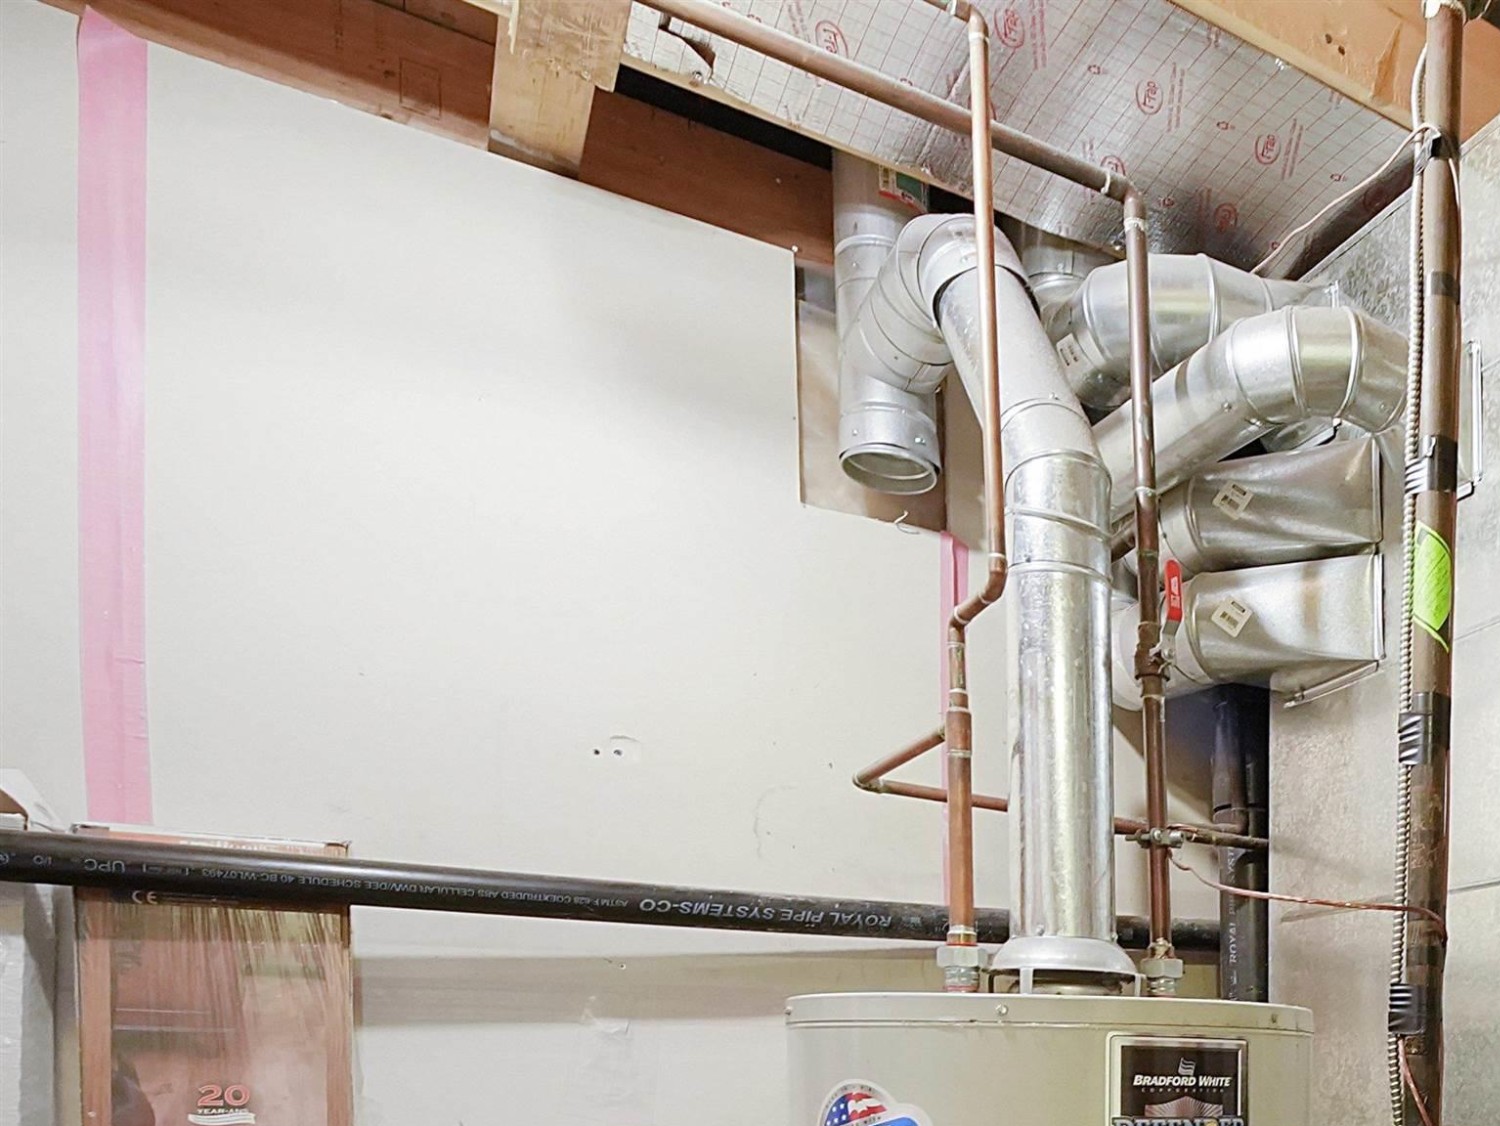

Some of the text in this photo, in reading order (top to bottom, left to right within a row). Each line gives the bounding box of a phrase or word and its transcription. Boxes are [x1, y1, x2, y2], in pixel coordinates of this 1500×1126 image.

[84, 858, 125, 873] UPC
[280, 874, 296, 884] 40
[298, 875, 361, 889] SCHEDULE
[500, 890, 572, 903] COEXTRUDED
[639, 899, 775, 920] SYSTEMS-CO
[780, 908, 824, 924] PIPE
[829, 911, 892, 927] ROYAL
[1133, 1074, 1232, 1087] BRADFORD WHITE
[197, 1084, 250, 1107] 20
